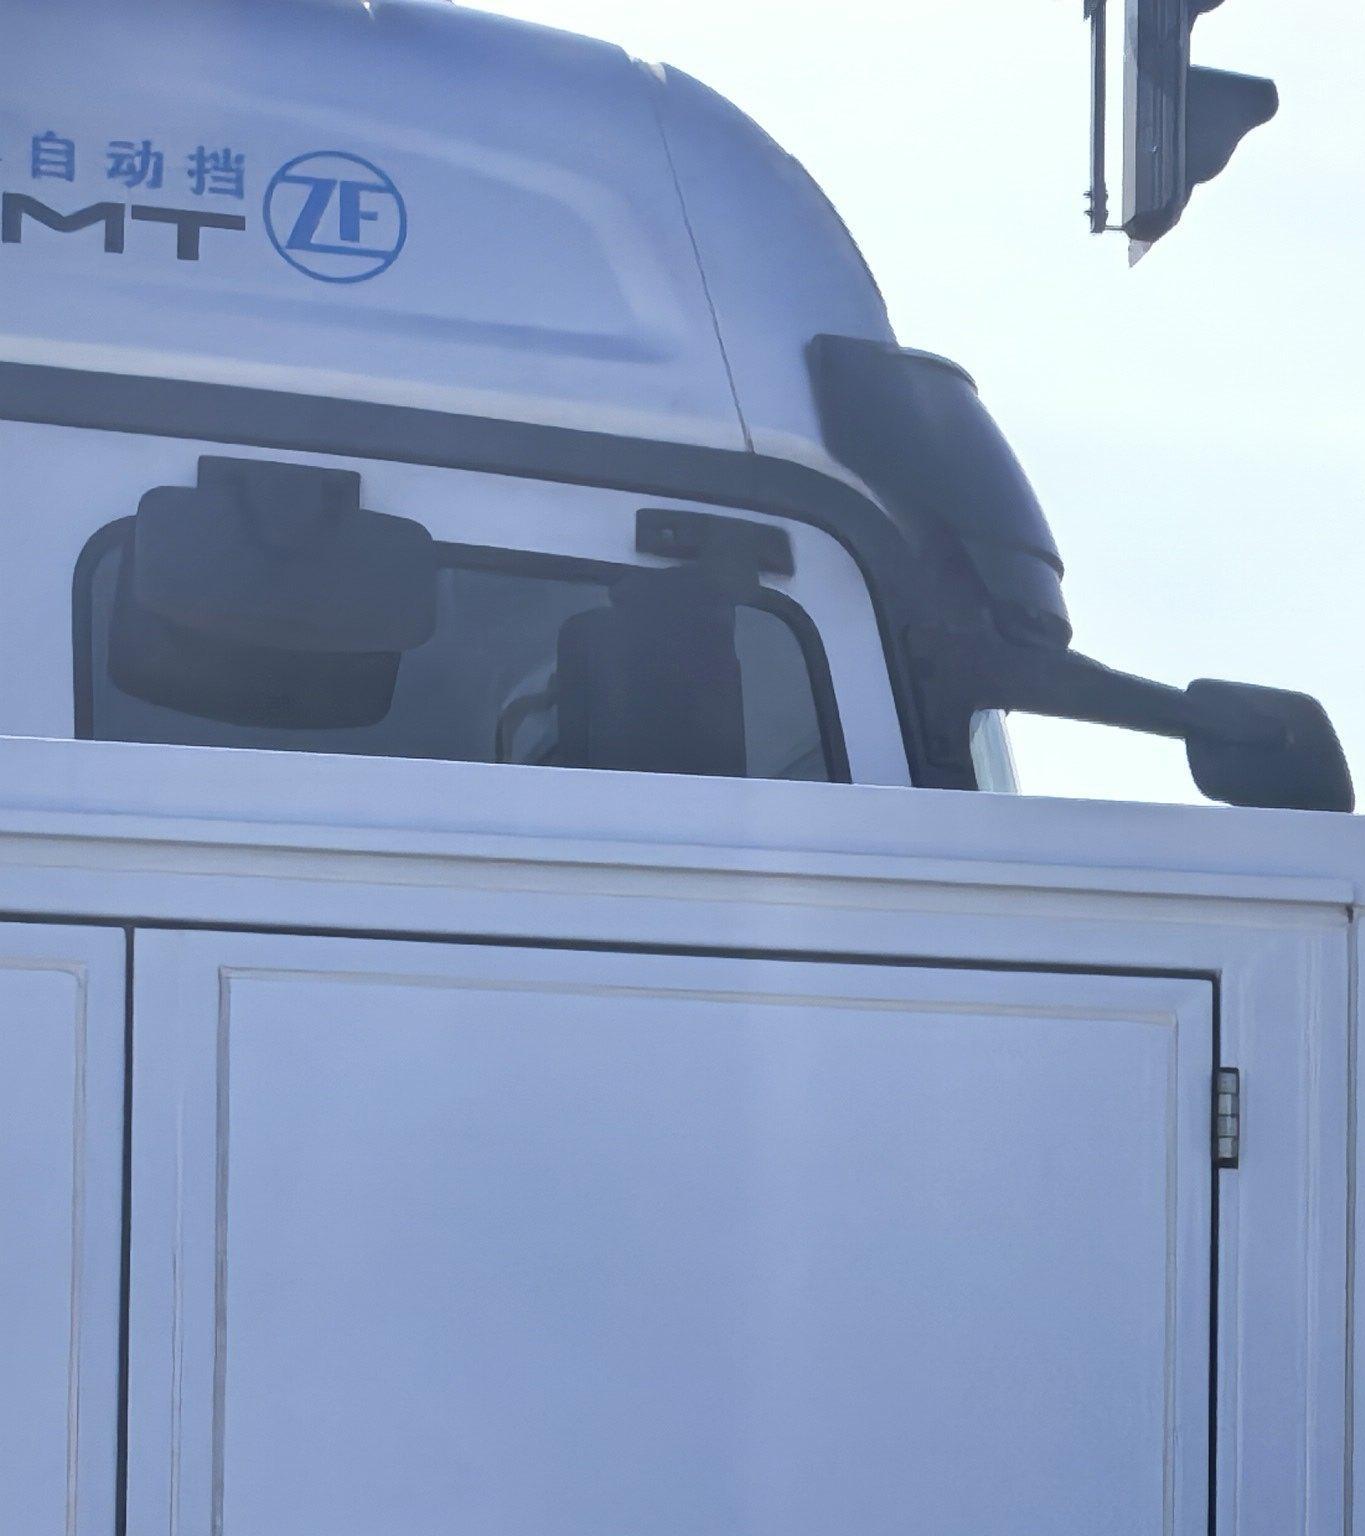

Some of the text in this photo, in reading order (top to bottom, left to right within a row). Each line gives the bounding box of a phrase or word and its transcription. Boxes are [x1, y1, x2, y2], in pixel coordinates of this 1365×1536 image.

[30, 130, 246, 199] 自动挡
[272, 172, 400, 261] ZF
